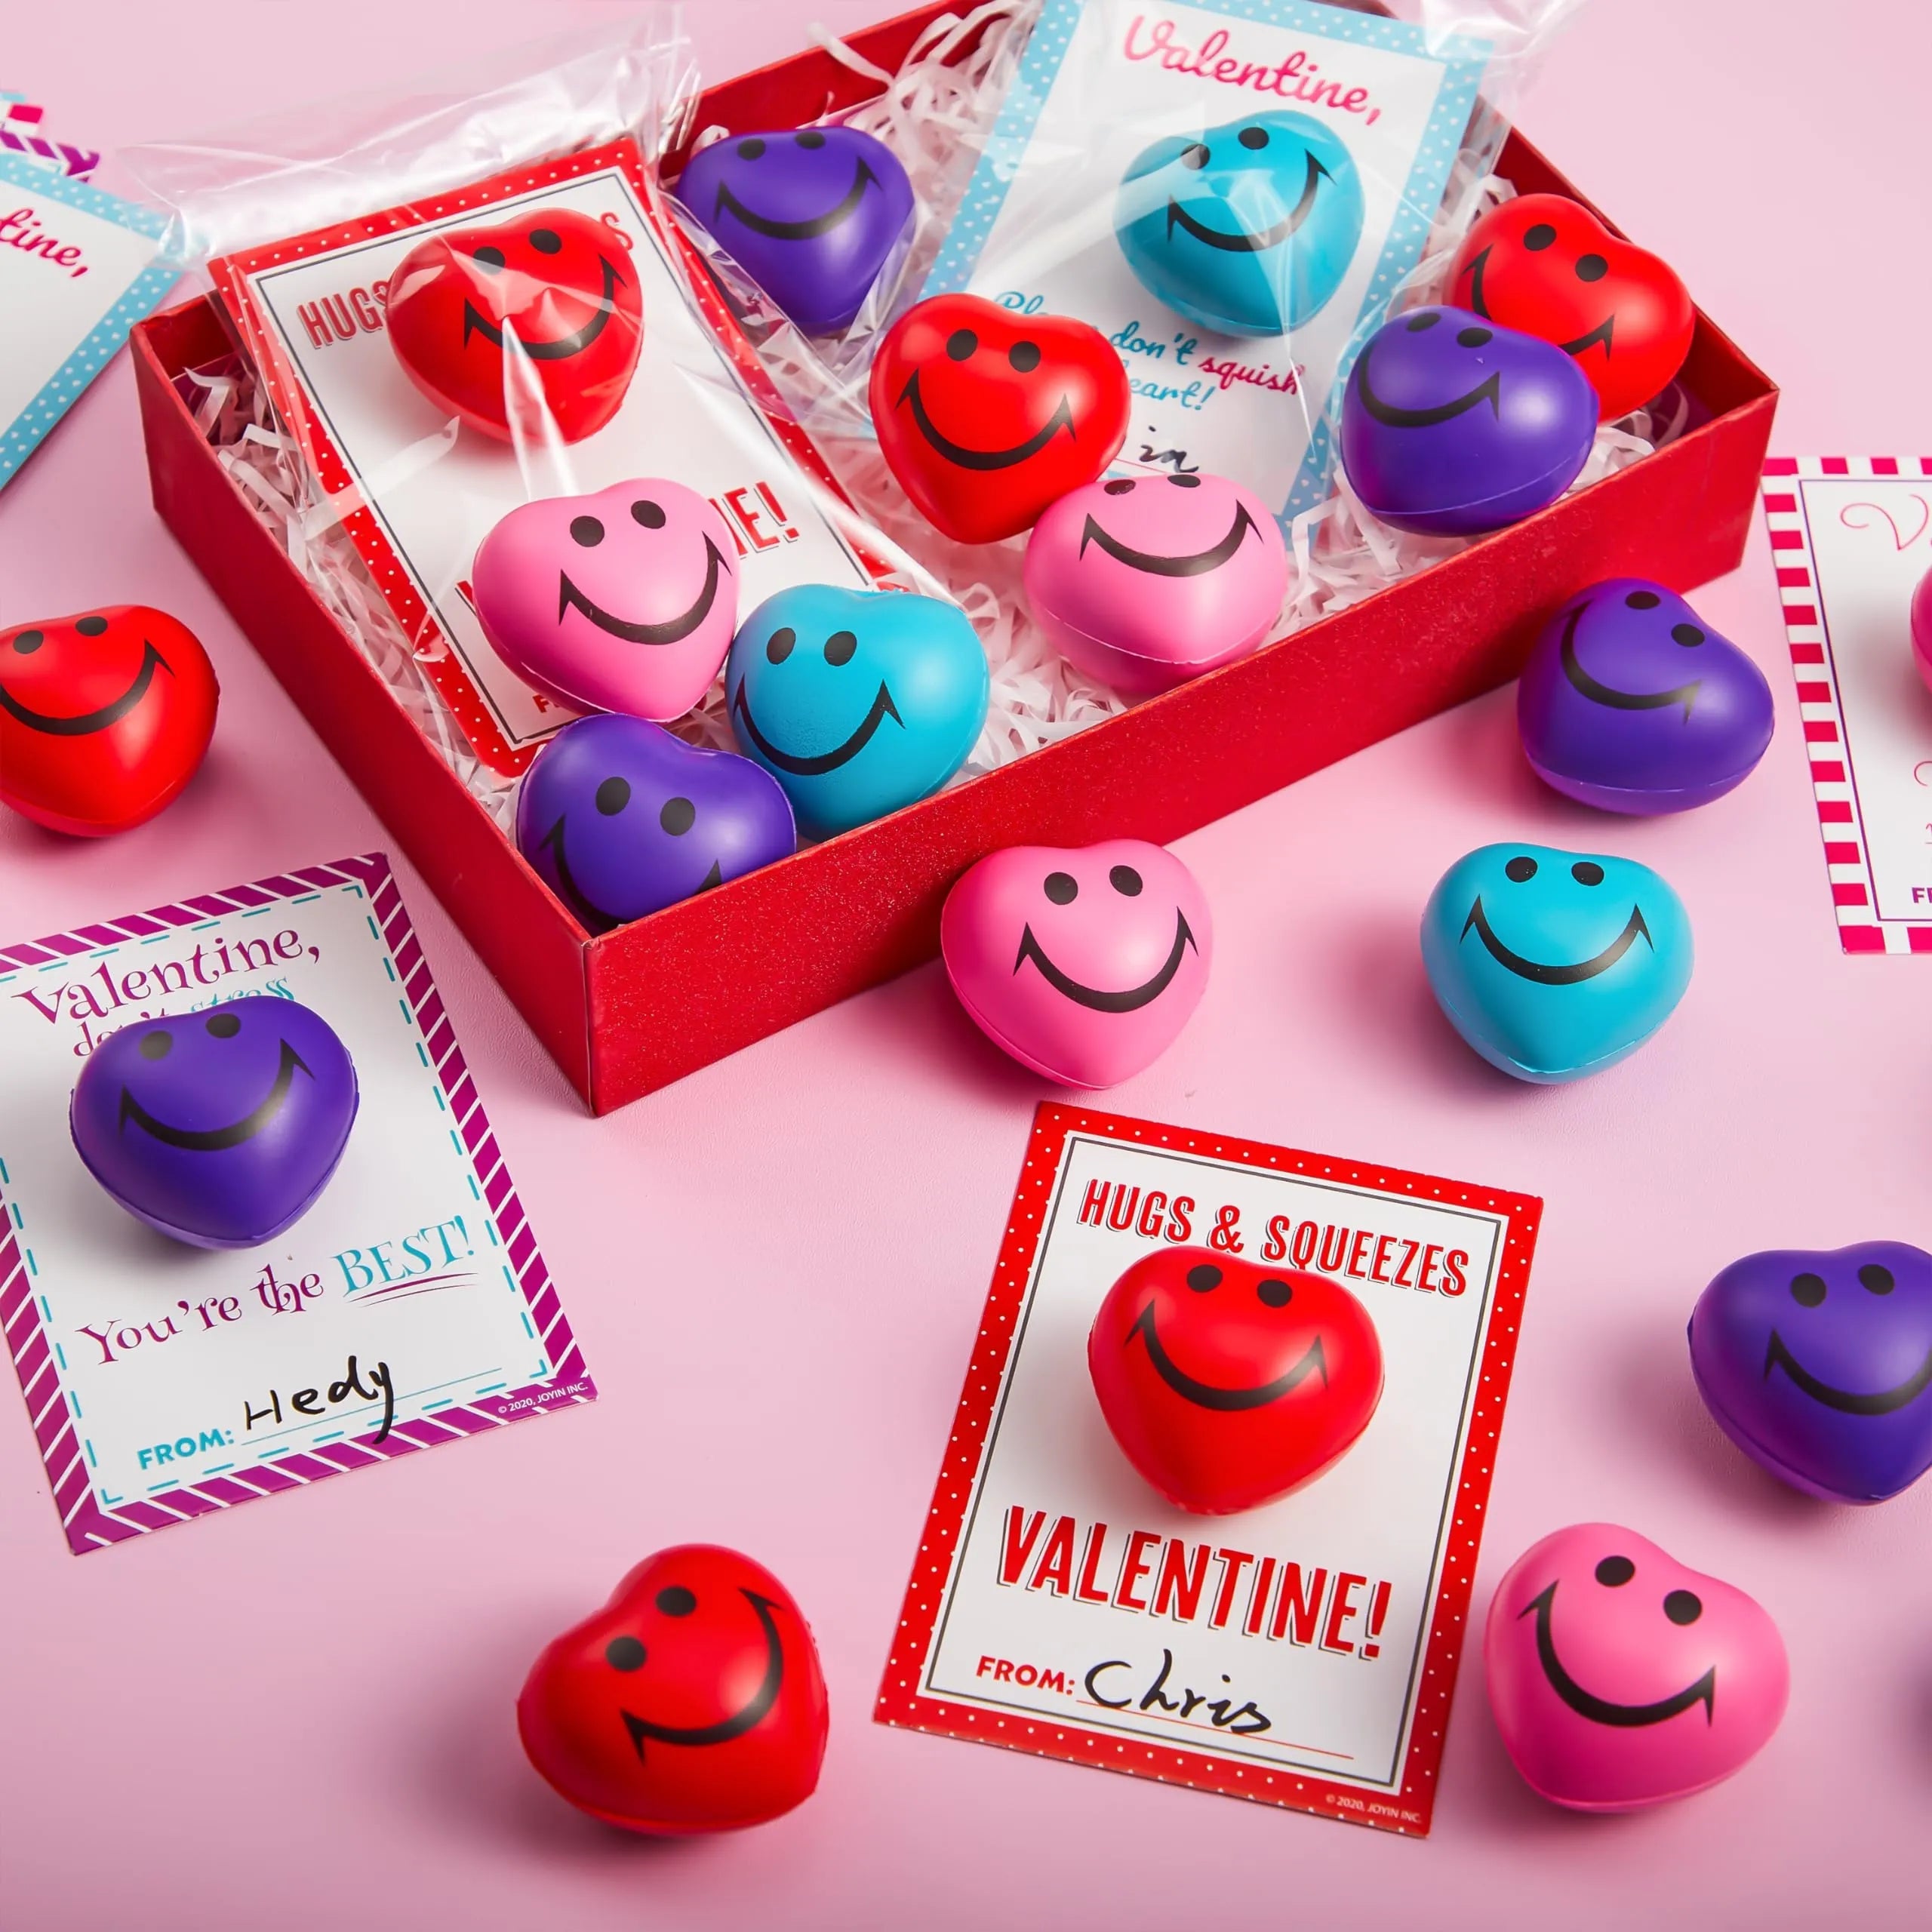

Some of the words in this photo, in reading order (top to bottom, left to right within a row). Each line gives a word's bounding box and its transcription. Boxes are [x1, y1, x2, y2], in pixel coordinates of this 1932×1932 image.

[1124, 15, 1381, 125] Valentine,
[1110, 321, 1198, 365] don't
[1198, 356, 1306, 395] squish
[1123, 360, 1217, 411] eart!
[11, 929, 320, 1026] Valentine,
[1076, 1179, 1195, 1244] HUGS
[1206, 1204, 1244, 1254] &
[1260, 1214, 1469, 1297] SQUEEZES
[75, 1294, 242, 1365] You're
[250, 1263, 324, 1316] the
[329, 1215, 475, 1297] BEST!
[244, 1355, 394, 1444] Hedy
[508, 1397, 536, 1412] 2020,
[537, 1387, 567, 1404] JOYIN
[567, 1382, 589, 1395] INC.
[136, 1428, 235, 1470] FROM:
[996, 1505, 1392, 1662] VALENTINE!
[976, 1655, 1076, 1697] FROM:
[1084, 1648, 1272, 1734] Chris
